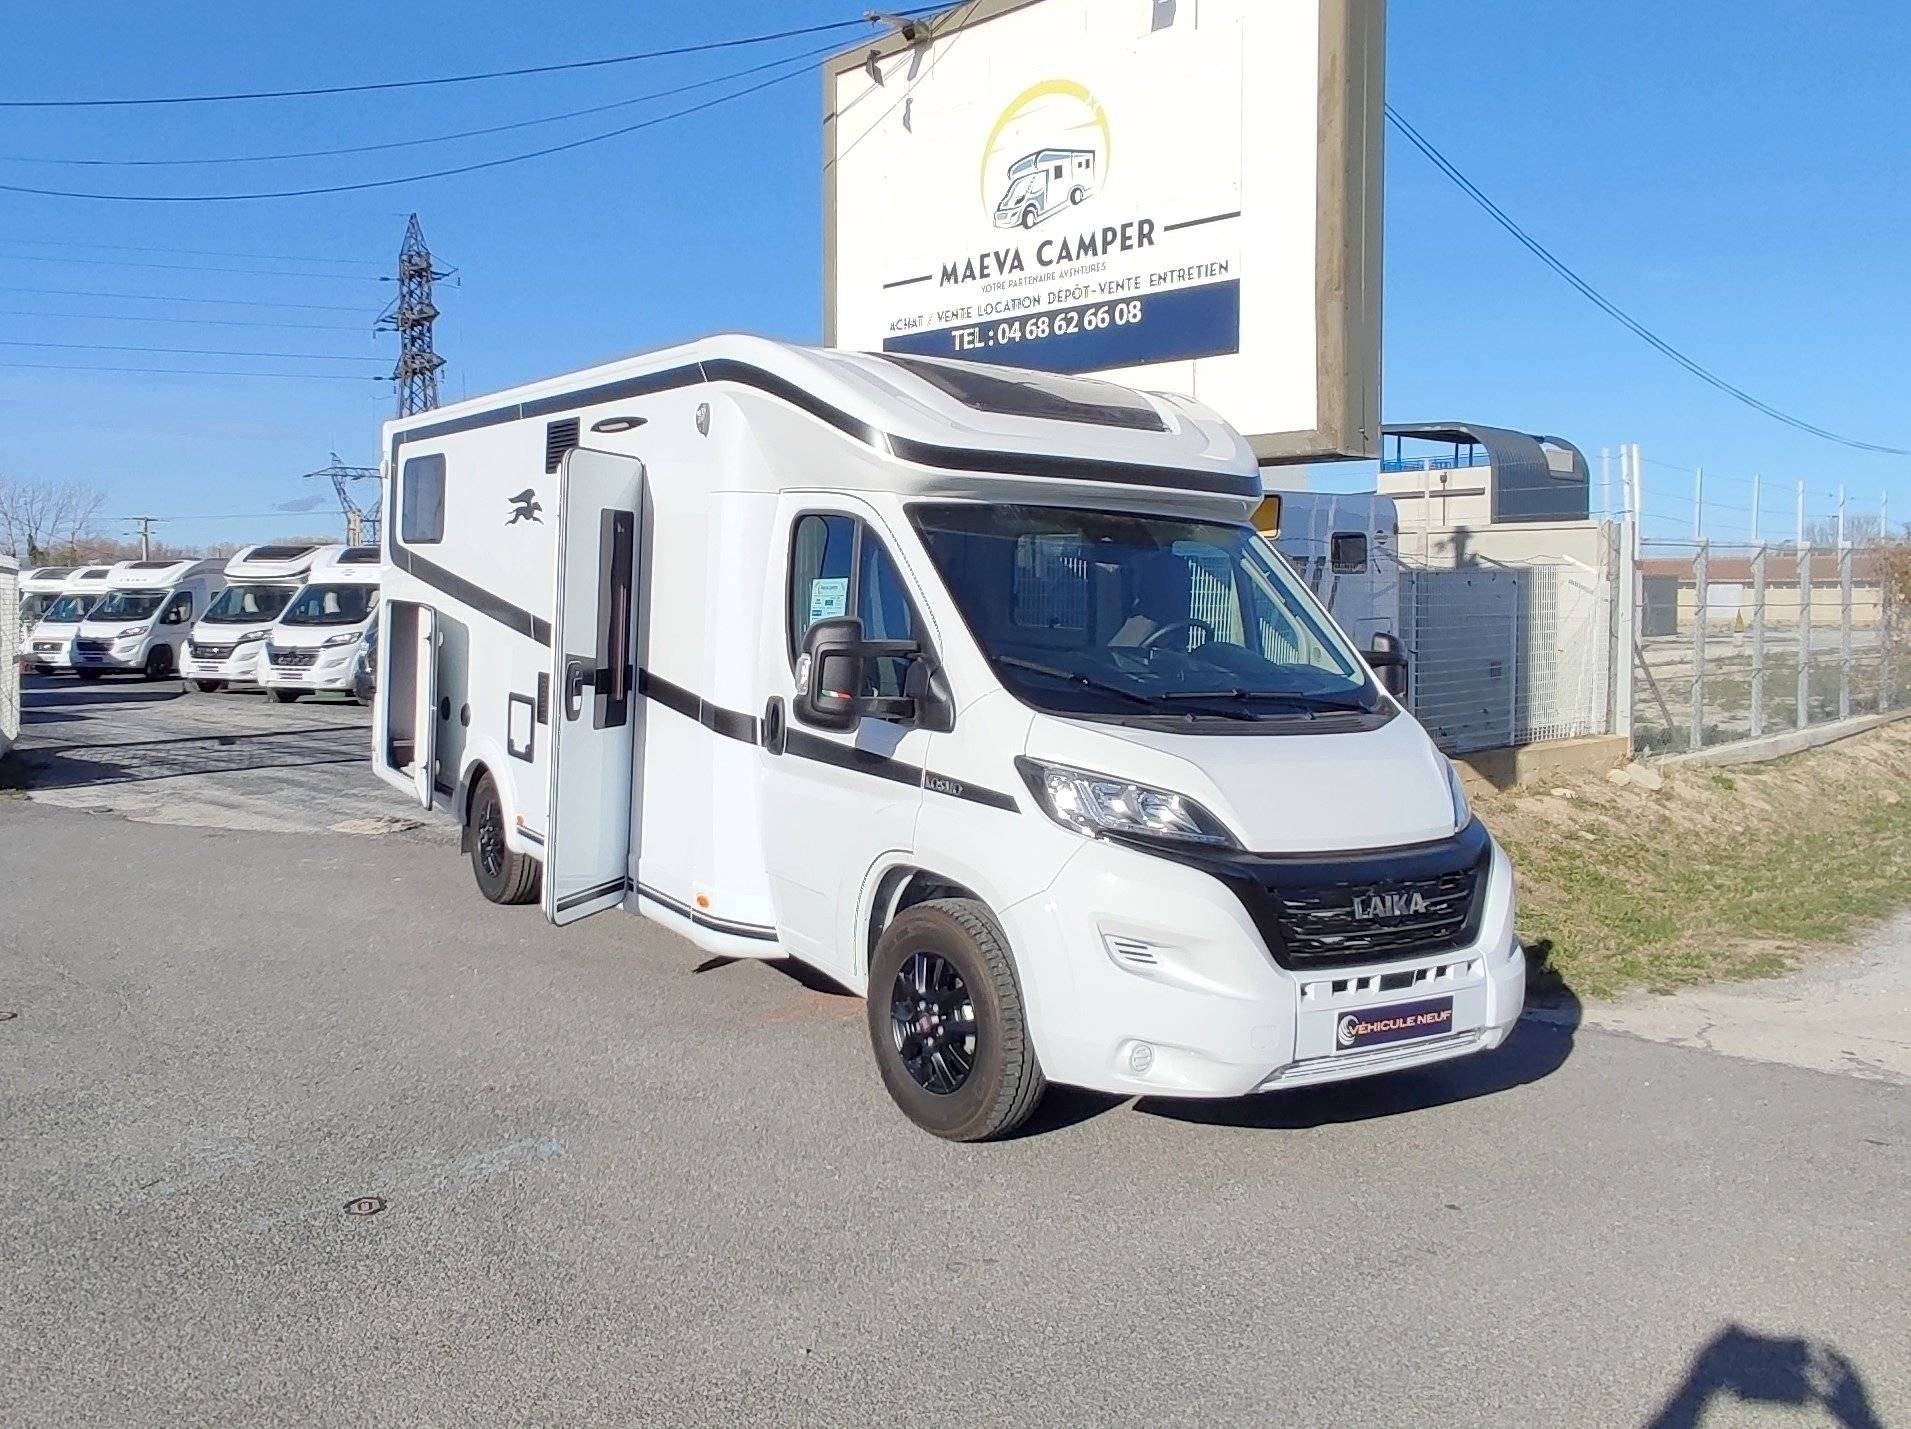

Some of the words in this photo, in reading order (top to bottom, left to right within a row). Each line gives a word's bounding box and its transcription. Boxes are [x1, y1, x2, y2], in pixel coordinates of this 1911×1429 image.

[939, 246, 1025, 287] MAEVA
[1036, 218, 1155, 267] CAMPER
[889, 315, 924, 332] ACHAT
[937, 306, 973, 323] VENTE
[977, 294, 1041, 316] LOCATION
[1149, 259, 1230, 288] ENTRETIEN
[981, 282, 1006, 294] VOTRE
[1008, 271, 1056, 288] PARTENAIRE
[1058, 261, 1107, 279] AVENTURES
[997, 321, 1022, 345] 04
[1025, 316, 1050, 340] 68
[1053, 311, 1079, 334] 62
[1083, 307, 1110, 330] 66
[1114, 300, 1142, 324] 08
[1353, 892, 1426, 920] LAIKA
[1417, 1010, 1452, 1025] NEUF
